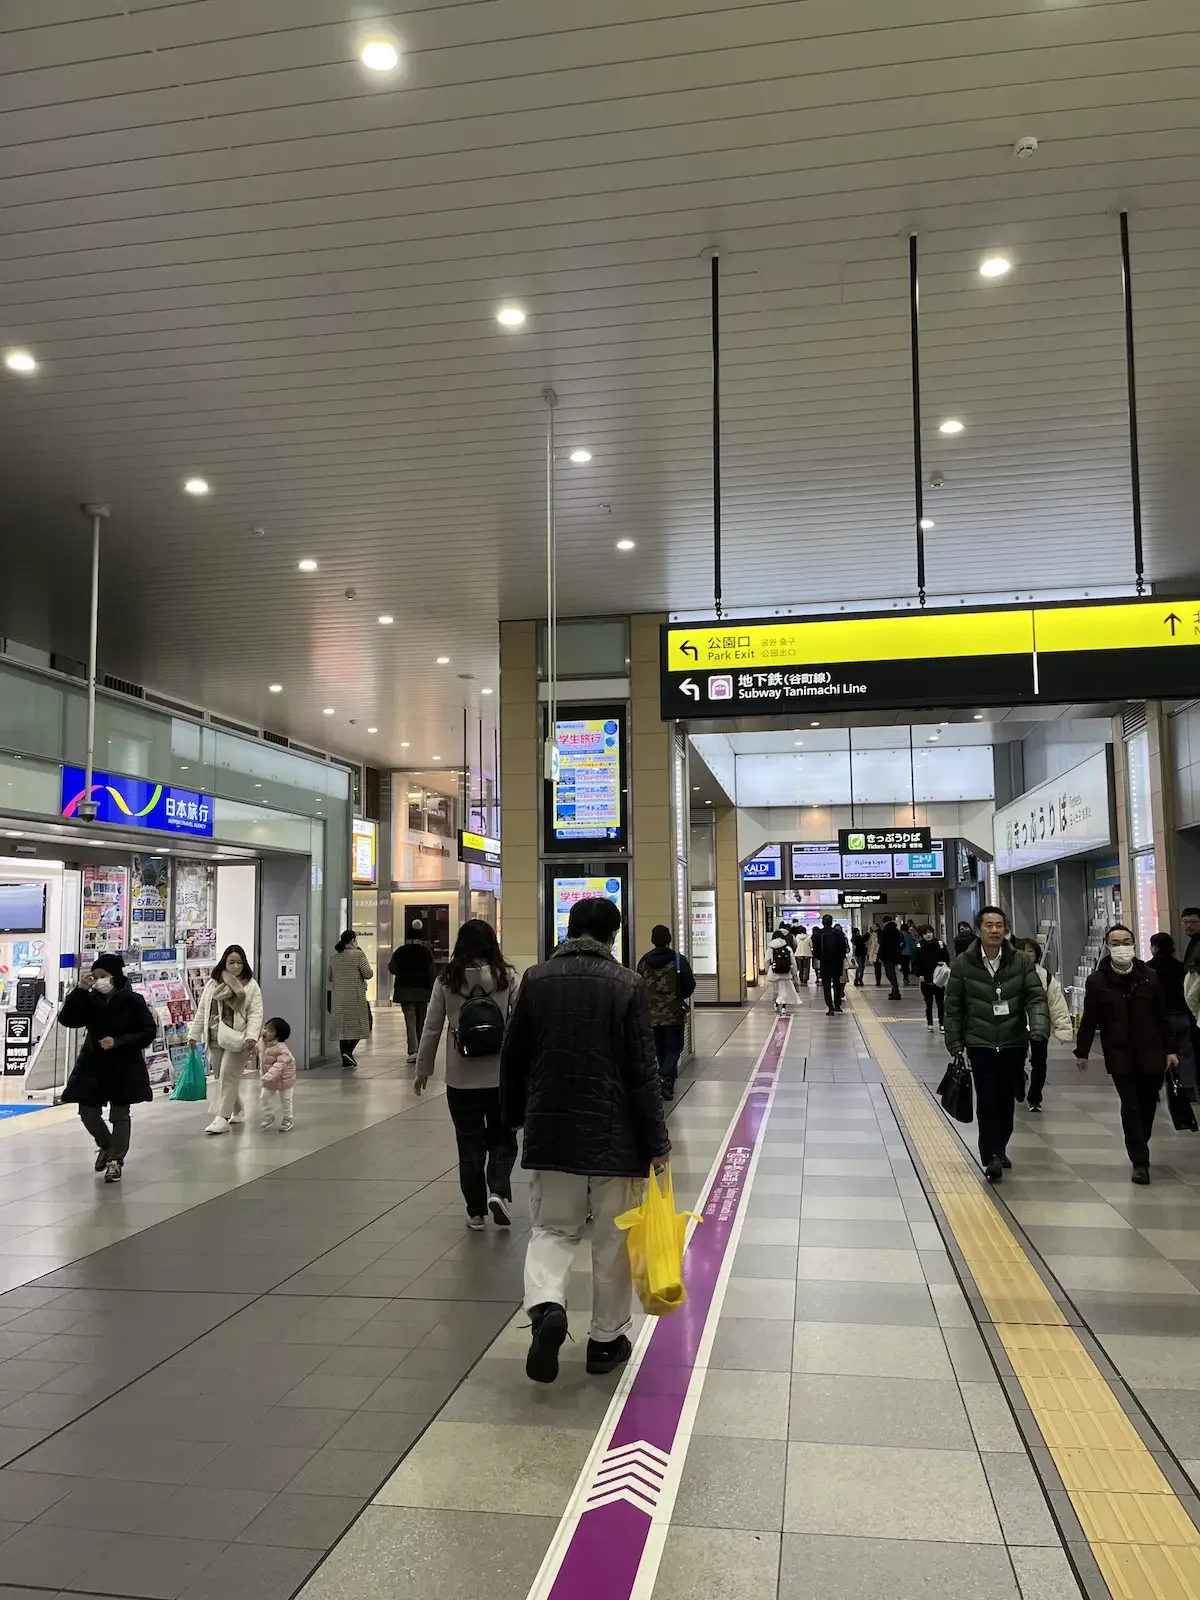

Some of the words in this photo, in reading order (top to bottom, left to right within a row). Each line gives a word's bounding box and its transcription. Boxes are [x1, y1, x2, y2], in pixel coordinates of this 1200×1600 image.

[708, 636, 750, 649] 公園口
[708, 650, 731, 660] Park
[735, 649, 755, 659] Exit
[737, 671, 831, 688] 地下鉄(谷町線)
[738, 688, 781, 700] Subway
[783, 684, 840, 697] Tanimachi
[843, 683, 868, 693] Line
[559, 733, 602, 745] 学生旅行
[166, 797, 209, 822] 日本旅行
[866, 832, 921, 843] きっぷうりば
[854, 859, 871, 867] flying
[872, 858, 887, 866] tiger
[912, 854, 932, 864] ニトリ
[744, 863, 769, 872] KALDI
